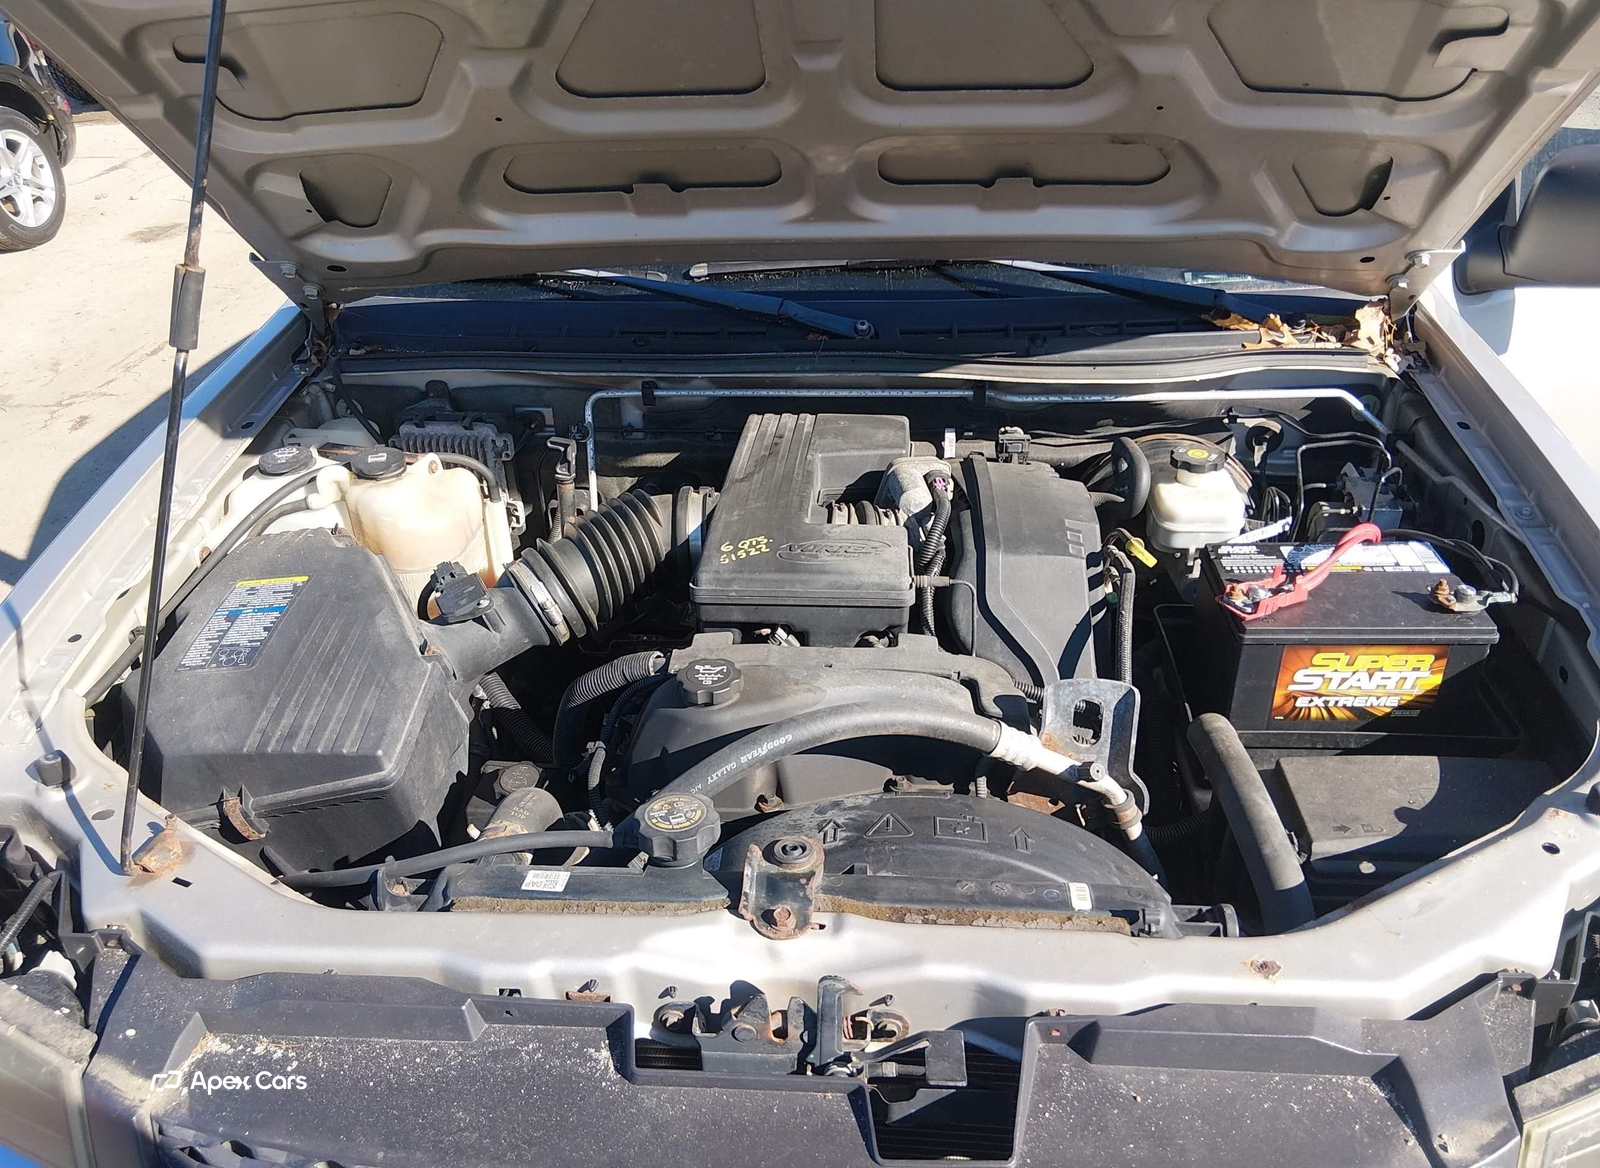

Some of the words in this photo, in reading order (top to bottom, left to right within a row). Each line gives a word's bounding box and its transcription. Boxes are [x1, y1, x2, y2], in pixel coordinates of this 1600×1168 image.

[720, 544, 770, 564] 51522
[721, 541, 734, 552] 6
[1308, 652, 1435, 672] SUPER
[1287, 669, 1432, 692] START
[1295, 695, 1402, 708] EXTREME
[740, 733, 793, 764] GOODYEAR
[706, 761, 737, 785] GALAXY
